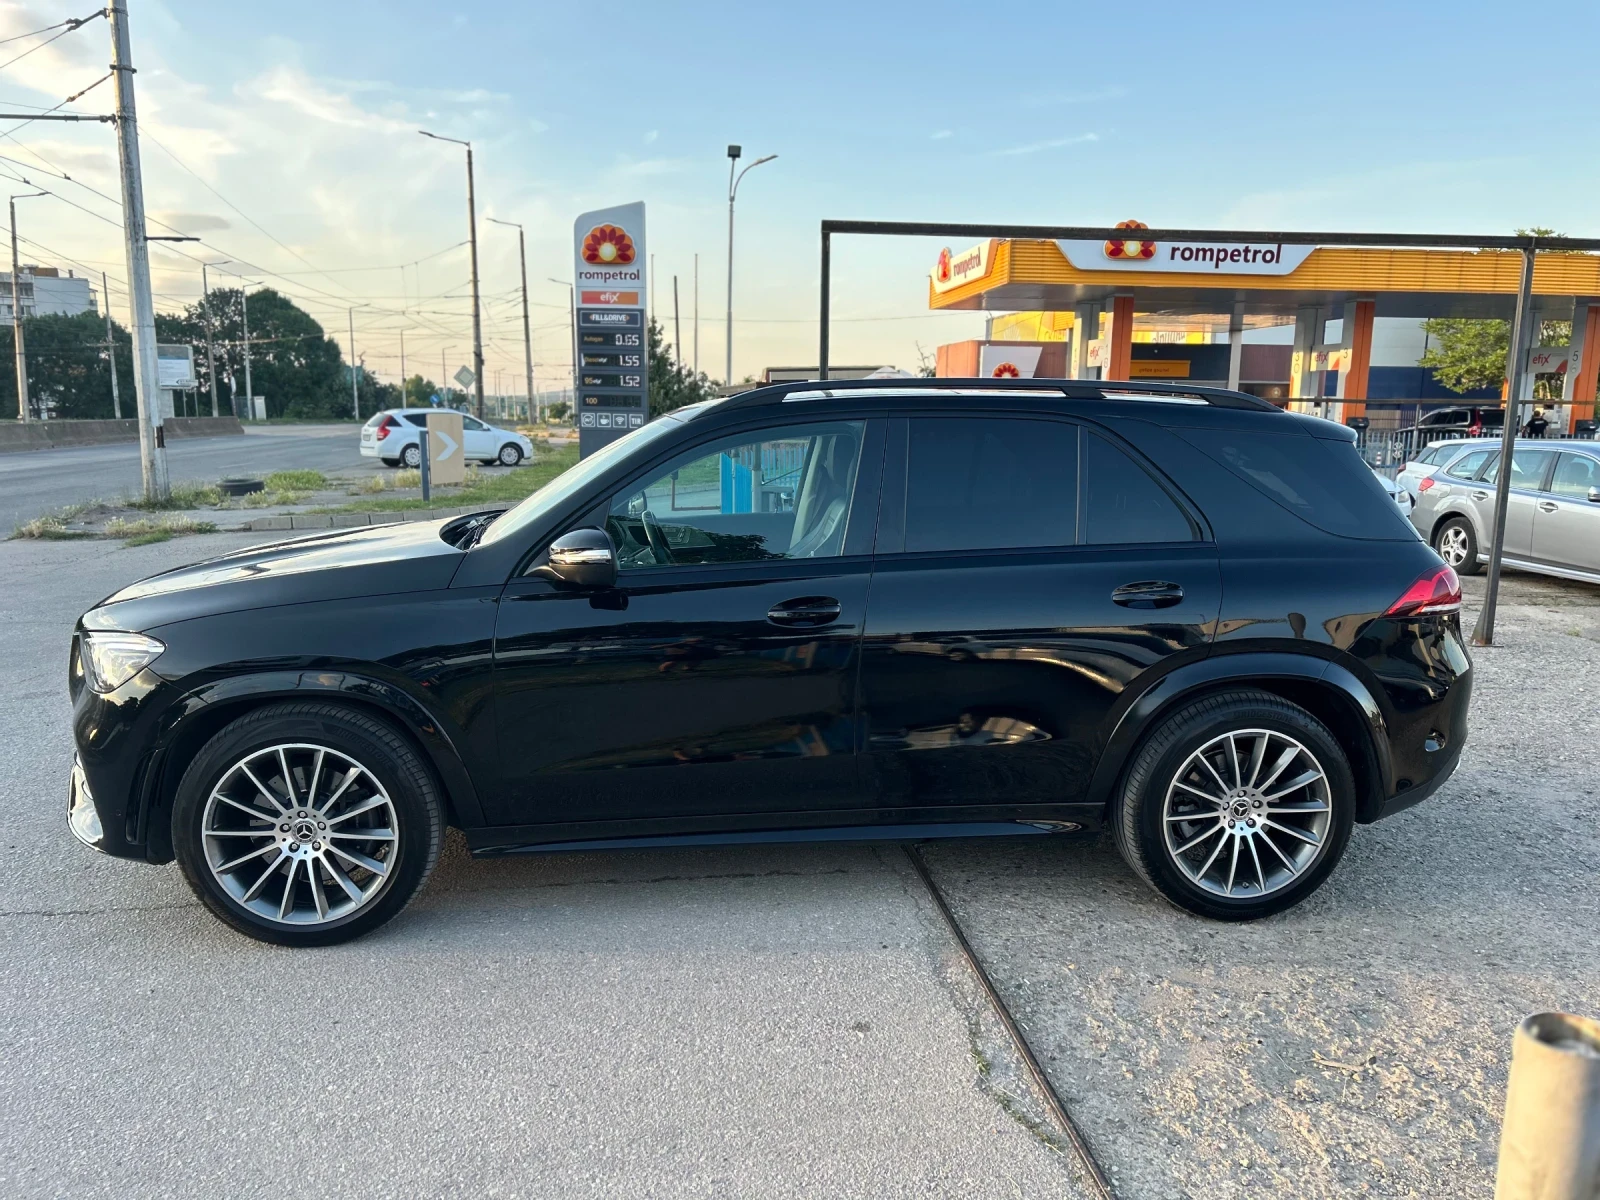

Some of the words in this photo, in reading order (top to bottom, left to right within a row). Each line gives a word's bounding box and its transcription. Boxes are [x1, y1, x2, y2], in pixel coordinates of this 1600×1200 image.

[1170, 243, 1282, 269] rompetrol
[953, 246, 981, 279] rompetrol
[579, 269, 640, 283] rompetrol
[600, 293, 619, 304] efix
[592, 313, 627, 321] FILL&DRIVE
[615, 334, 639, 346] 0.65
[619, 355, 640, 367] 1.55
[1532, 353, 1551, 366] efix
[1572, 350, 1579, 362] 5
[619, 375, 640, 387] 1.52
[585, 397, 598, 405] 100
